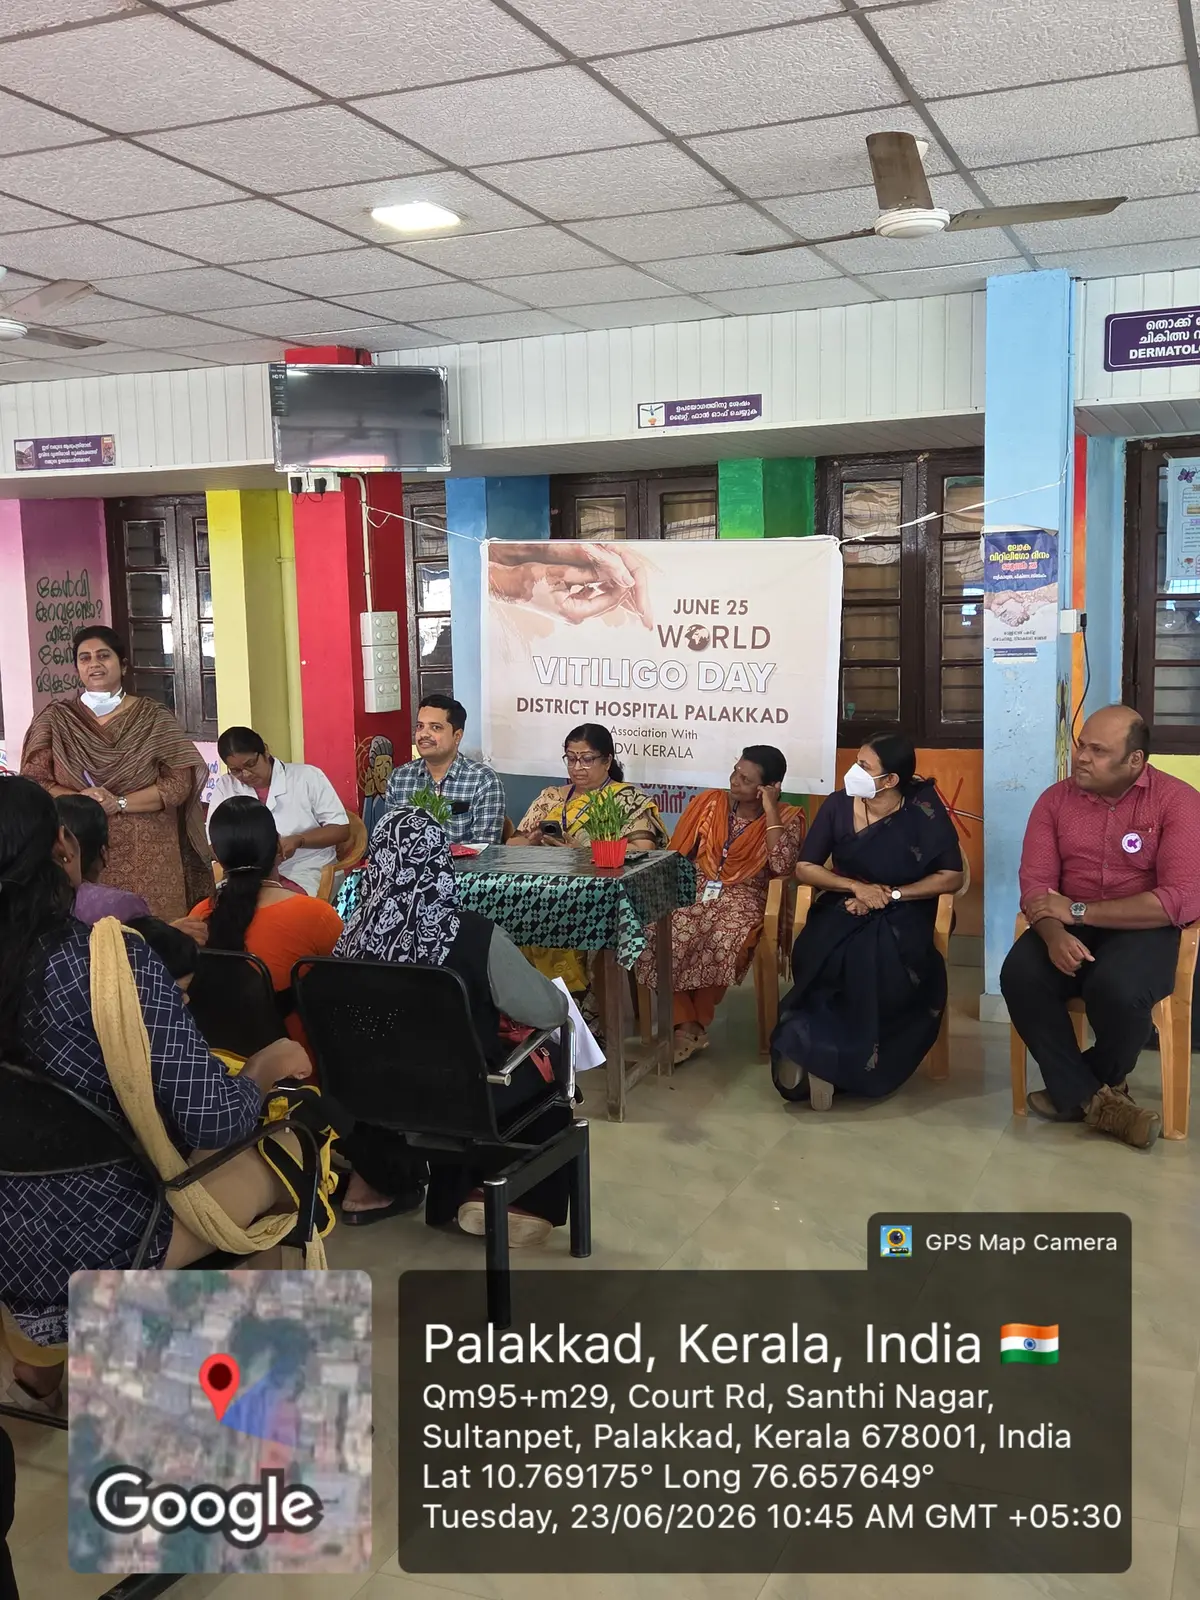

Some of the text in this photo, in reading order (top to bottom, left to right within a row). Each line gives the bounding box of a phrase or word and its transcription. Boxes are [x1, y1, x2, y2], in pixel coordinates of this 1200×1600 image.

[1138, 330, 1190, 345] ചികിത്സ
[1129, 343, 1200, 360] DERMATOL
[1007, 543, 1032, 551] ലോക
[673, 599, 748, 616] JUNE 25
[532, 655, 777, 694] VITILIGO DAY
[517, 697, 789, 724] DISTRICT HOSPITAL PALAKKAD
[610, 725, 698, 740] Association With
[614, 742, 694, 759] DVL KERALA
